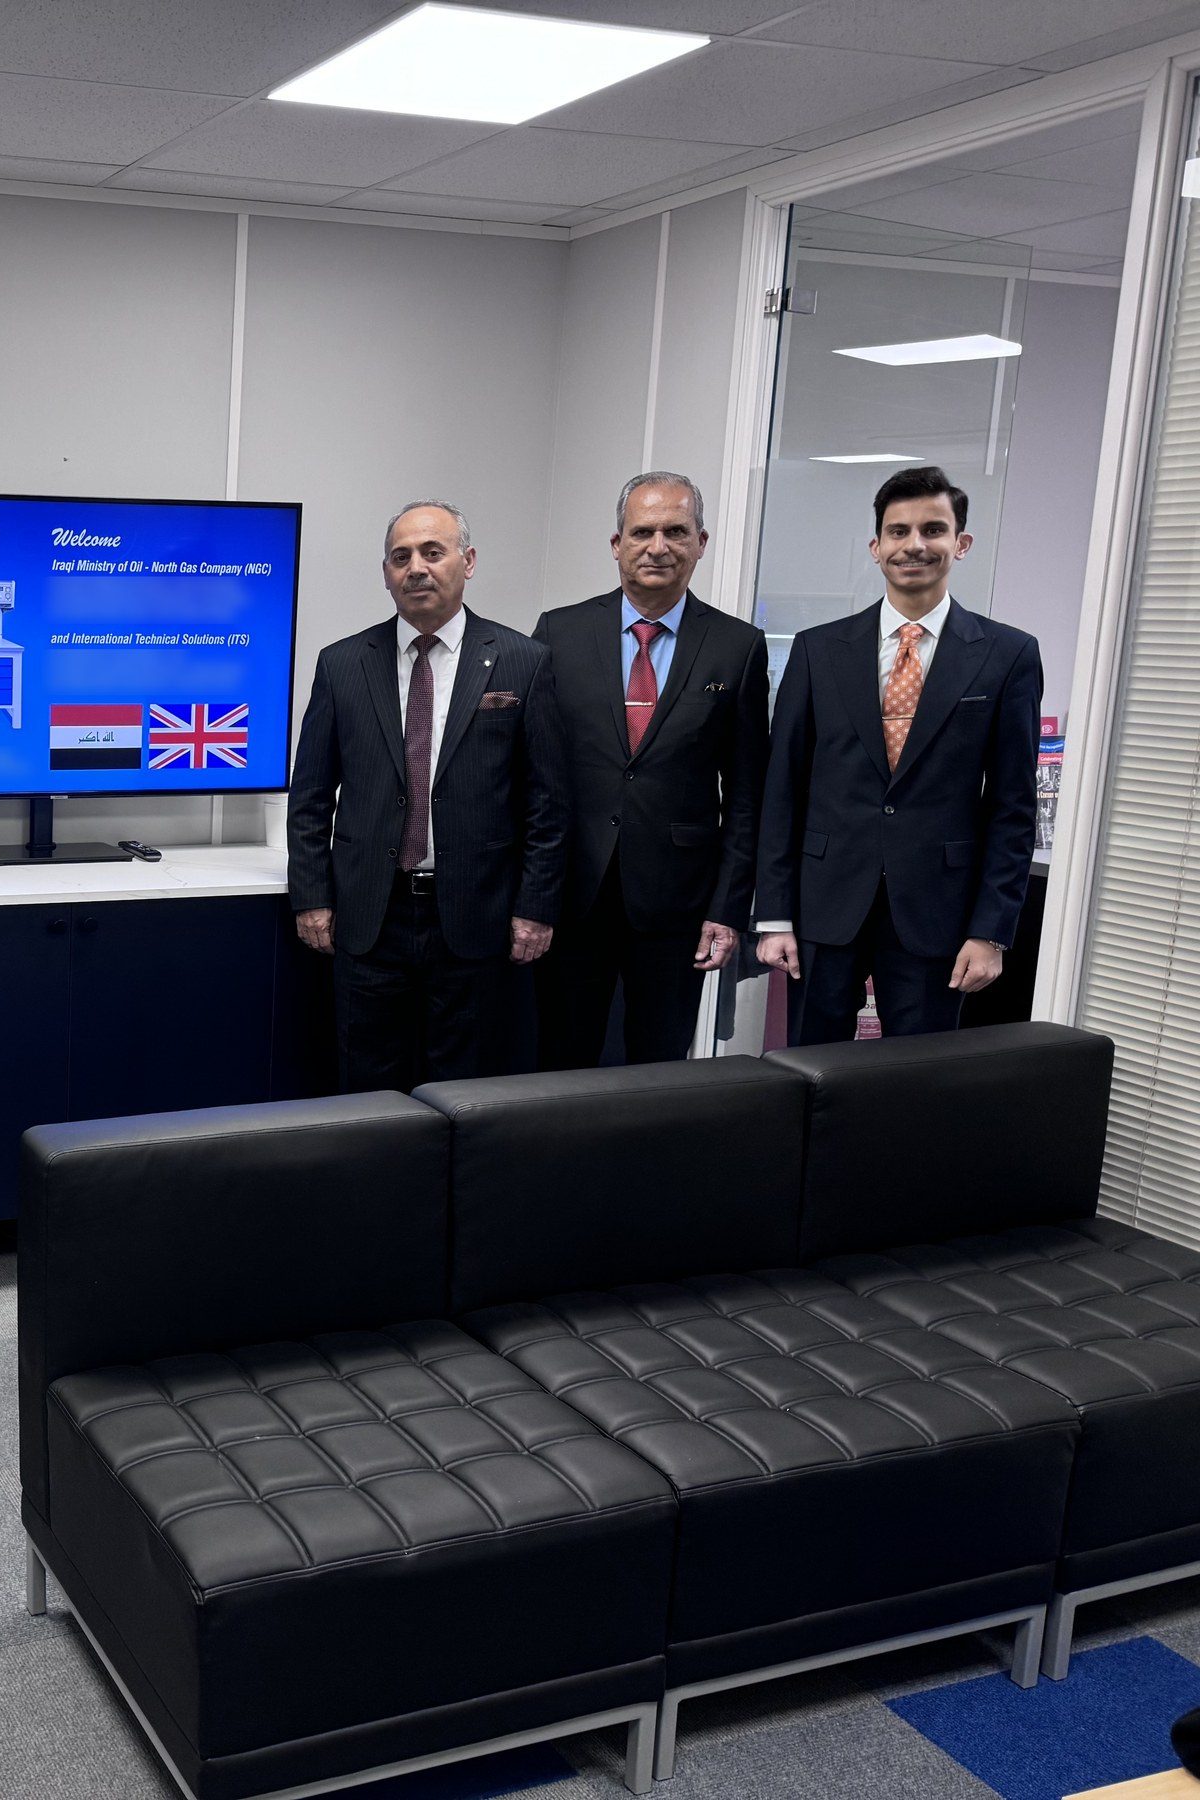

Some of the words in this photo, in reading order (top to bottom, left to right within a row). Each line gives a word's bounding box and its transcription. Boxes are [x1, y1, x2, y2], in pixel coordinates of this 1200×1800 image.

[51, 527, 121, 548] Welcome
[52, 559, 75, 573] Iraqi
[77, 560, 117, 574] Ministry
[118, 561, 129, 572] of
[130, 561, 144, 573] Oil
[151, 561, 178, 573] North
[180, 562, 198, 573] Gas
[199, 562, 242, 576] Company
[244, 563, 272, 577] (NGC)
[51, 633, 70, 644] and
[71, 633, 133, 645] International
[135, 633, 180, 645] Technical
[181, 634, 226, 645] Solutions
[227, 634, 250, 647] (ITS)
